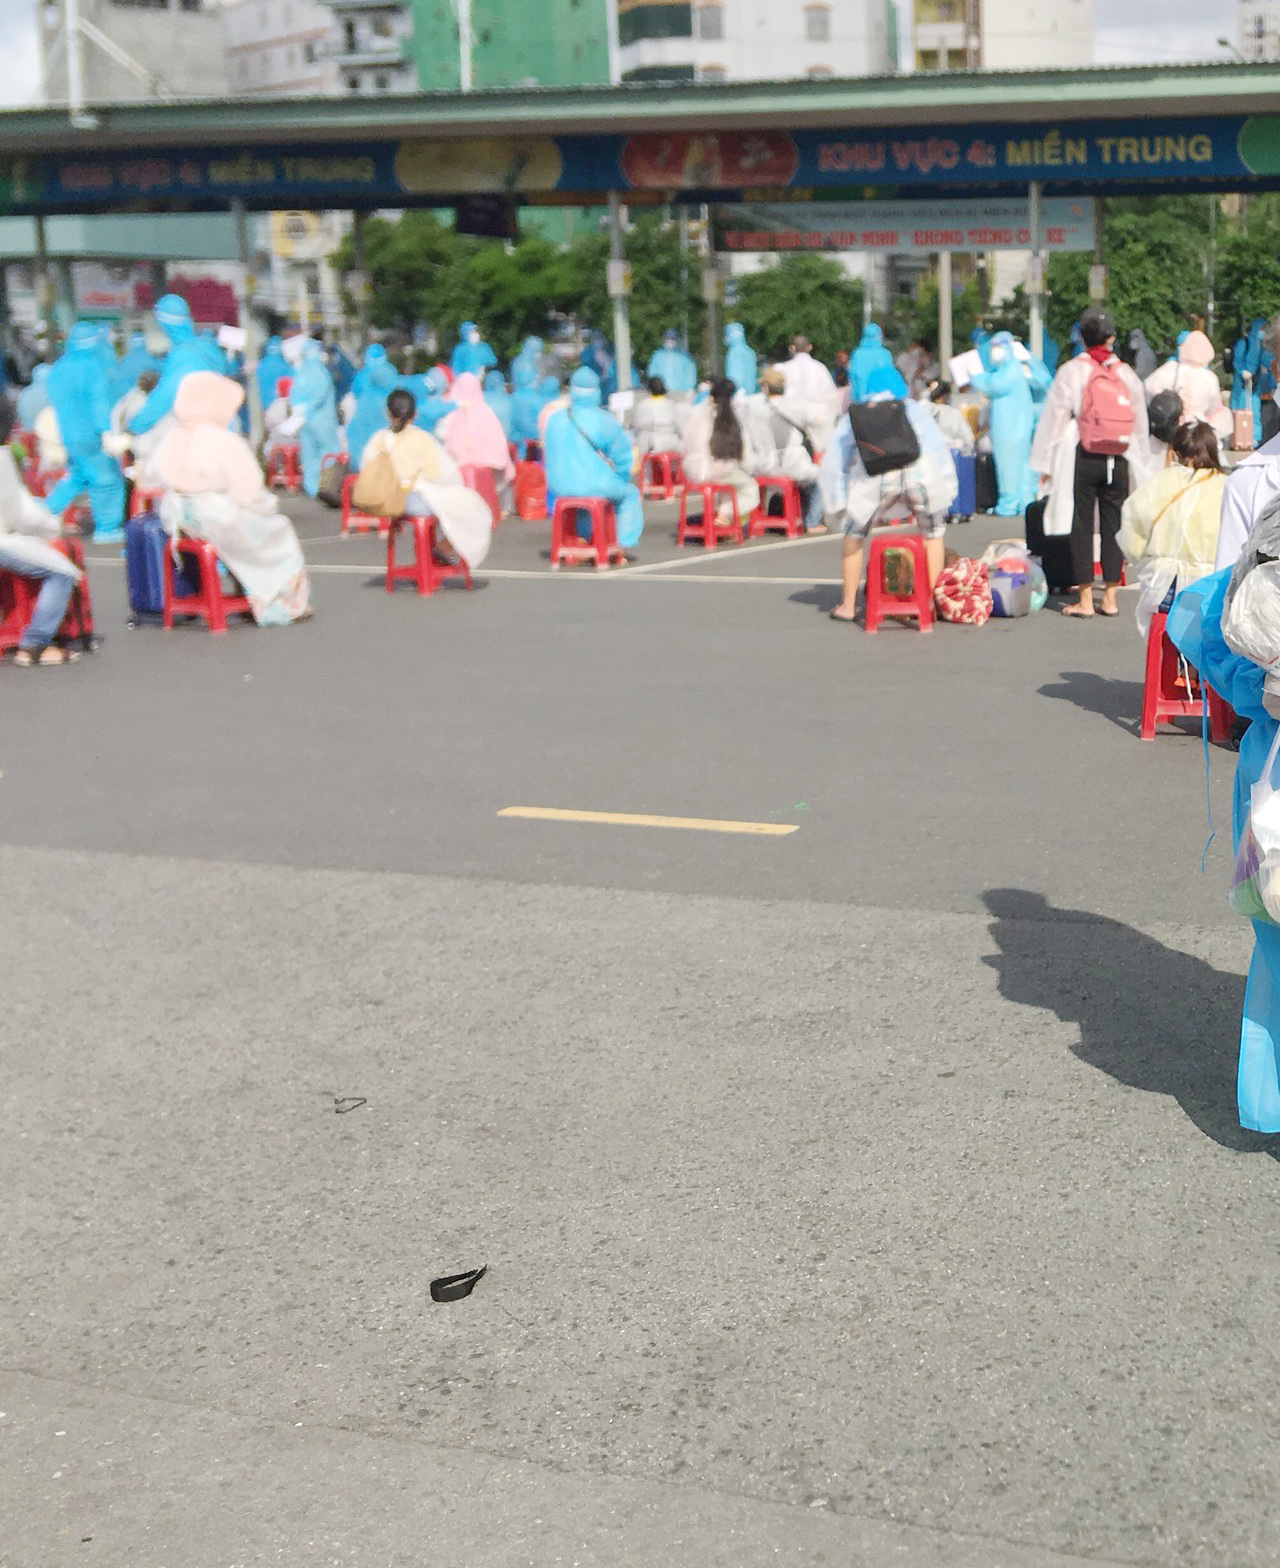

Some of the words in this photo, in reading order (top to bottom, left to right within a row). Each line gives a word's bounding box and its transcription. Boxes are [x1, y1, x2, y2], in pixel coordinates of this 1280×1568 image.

[817, 141, 886, 173] KHU
[892, 137, 962, 175] VỰC
[1005, 130, 1088, 166] MIỀN
[1100, 134, 1213, 164] TRUNG
